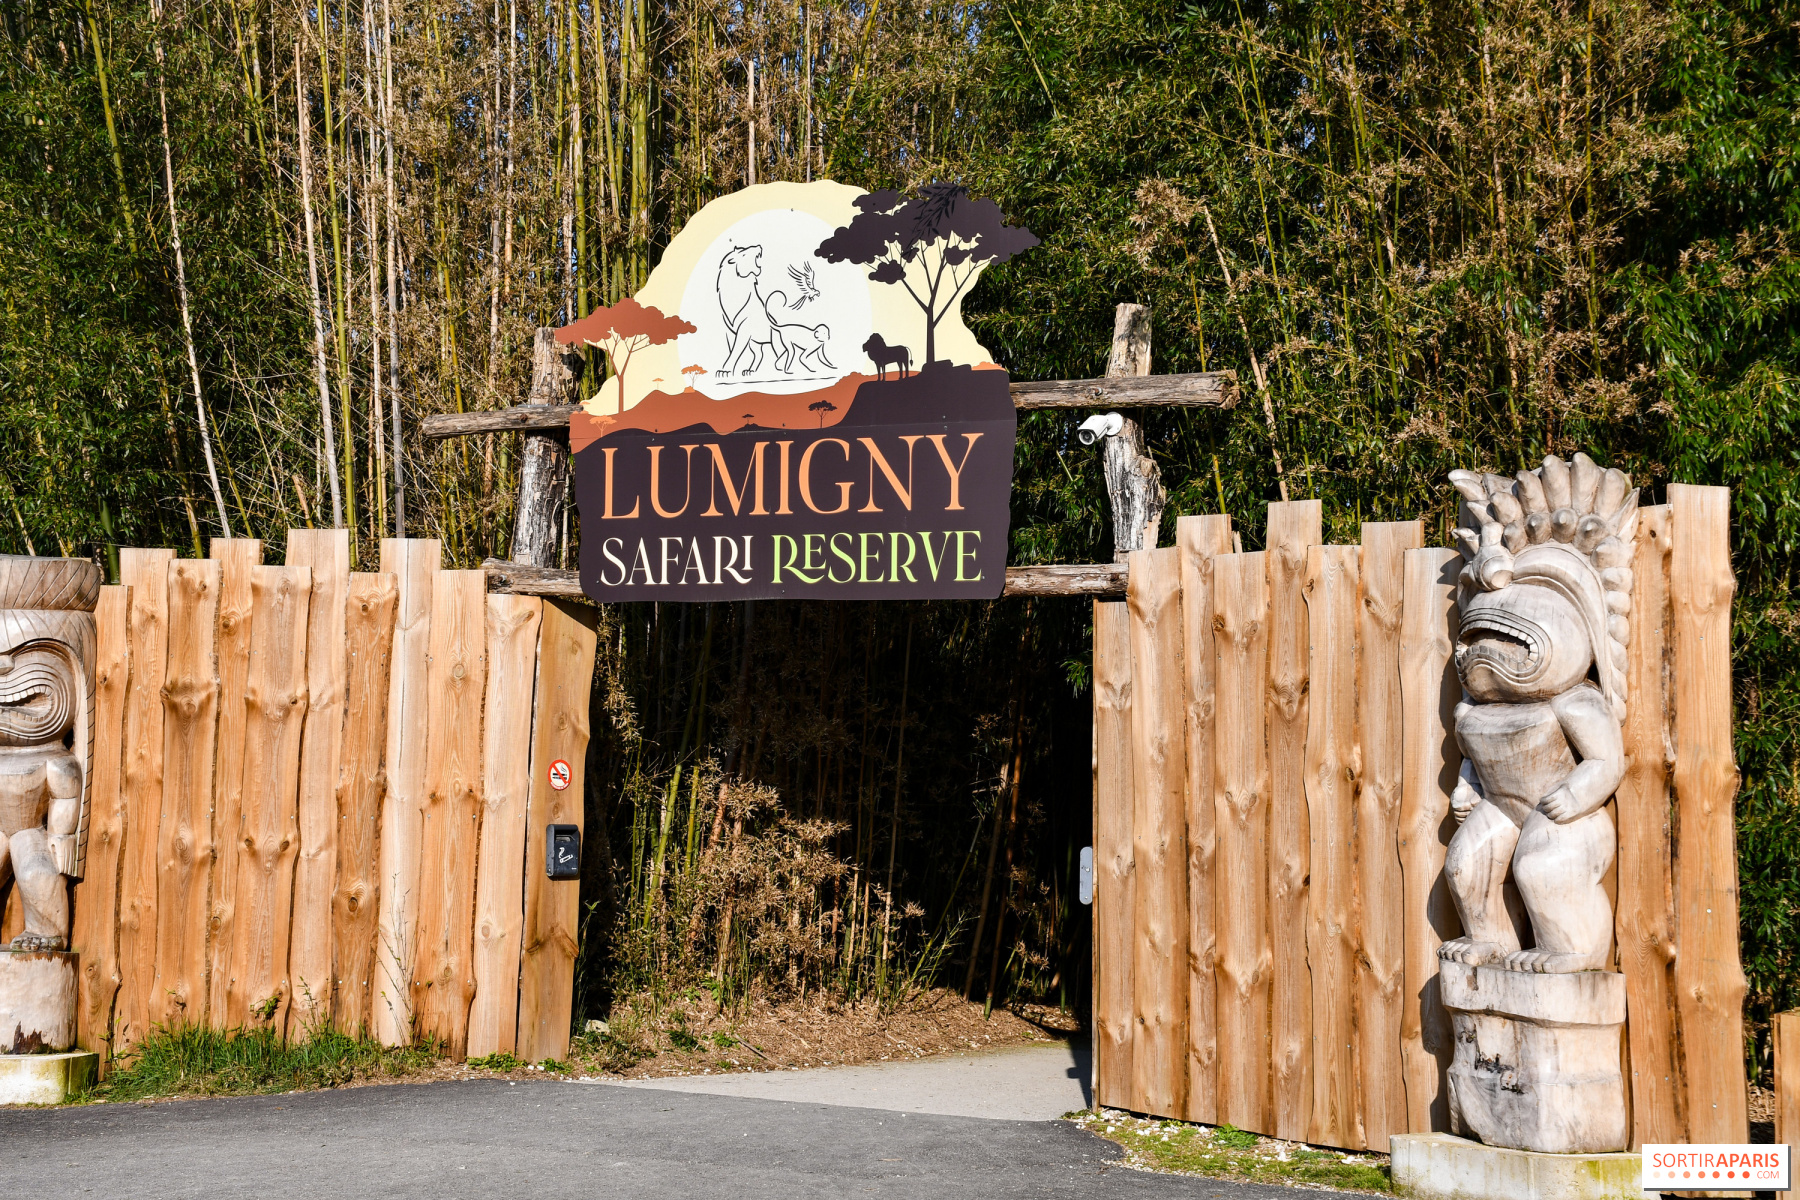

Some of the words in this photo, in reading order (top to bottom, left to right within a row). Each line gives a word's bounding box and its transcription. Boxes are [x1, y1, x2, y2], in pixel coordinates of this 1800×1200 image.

[601, 432, 985, 520] LUMIGNY
[600, 535, 754, 586] SAFARI
[770, 530, 983, 584] RESERVE
